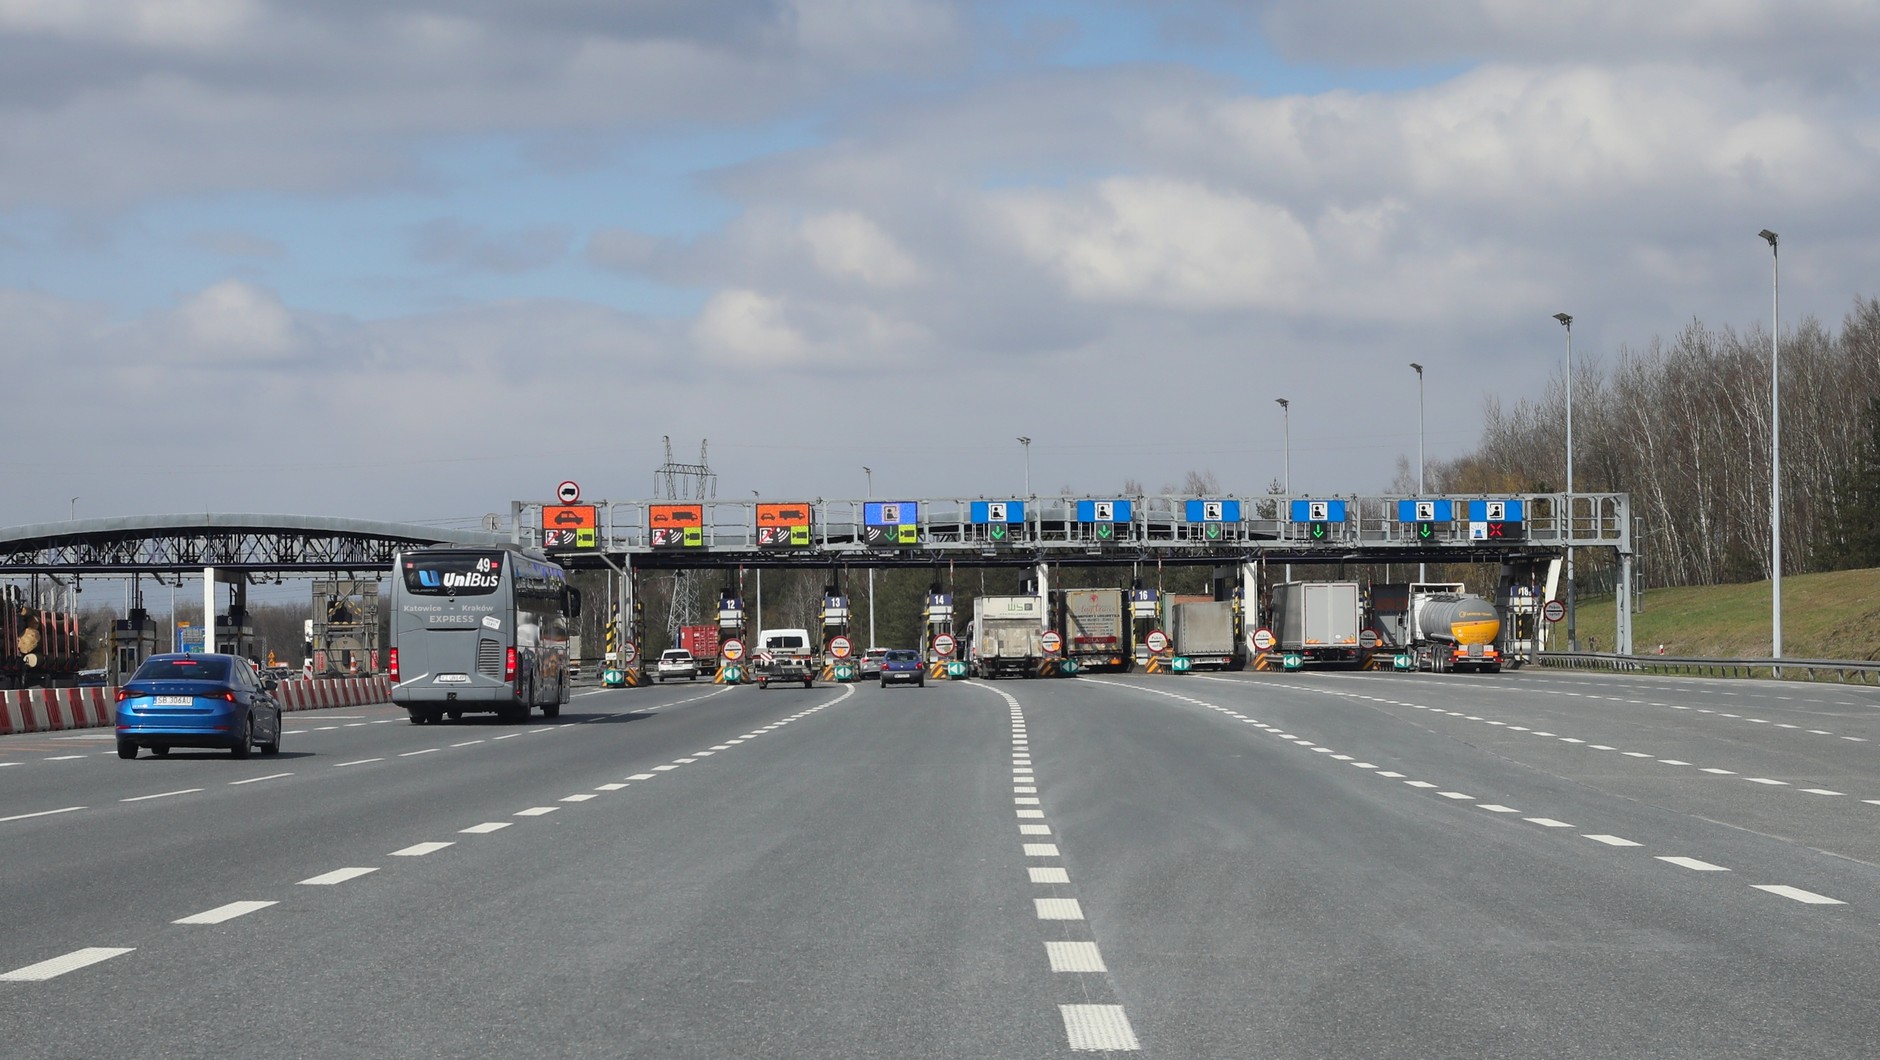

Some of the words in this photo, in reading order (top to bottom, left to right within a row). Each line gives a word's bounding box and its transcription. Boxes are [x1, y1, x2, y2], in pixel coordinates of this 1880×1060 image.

[476, 558, 491, 572] 49
[443, 572, 499, 587] UniBus
[935, 595, 944, 605] 14
[1139, 590, 1148, 600] 16
[726, 599, 735, 609] 12
[831, 597, 841, 608] 13
[403, 604, 442, 612] Katowice
[462, 604, 494, 612] Kraków
[227, 617, 232, 626] 6
[429, 615, 475, 623] EXPRESS
[127, 620, 132, 630] 5
